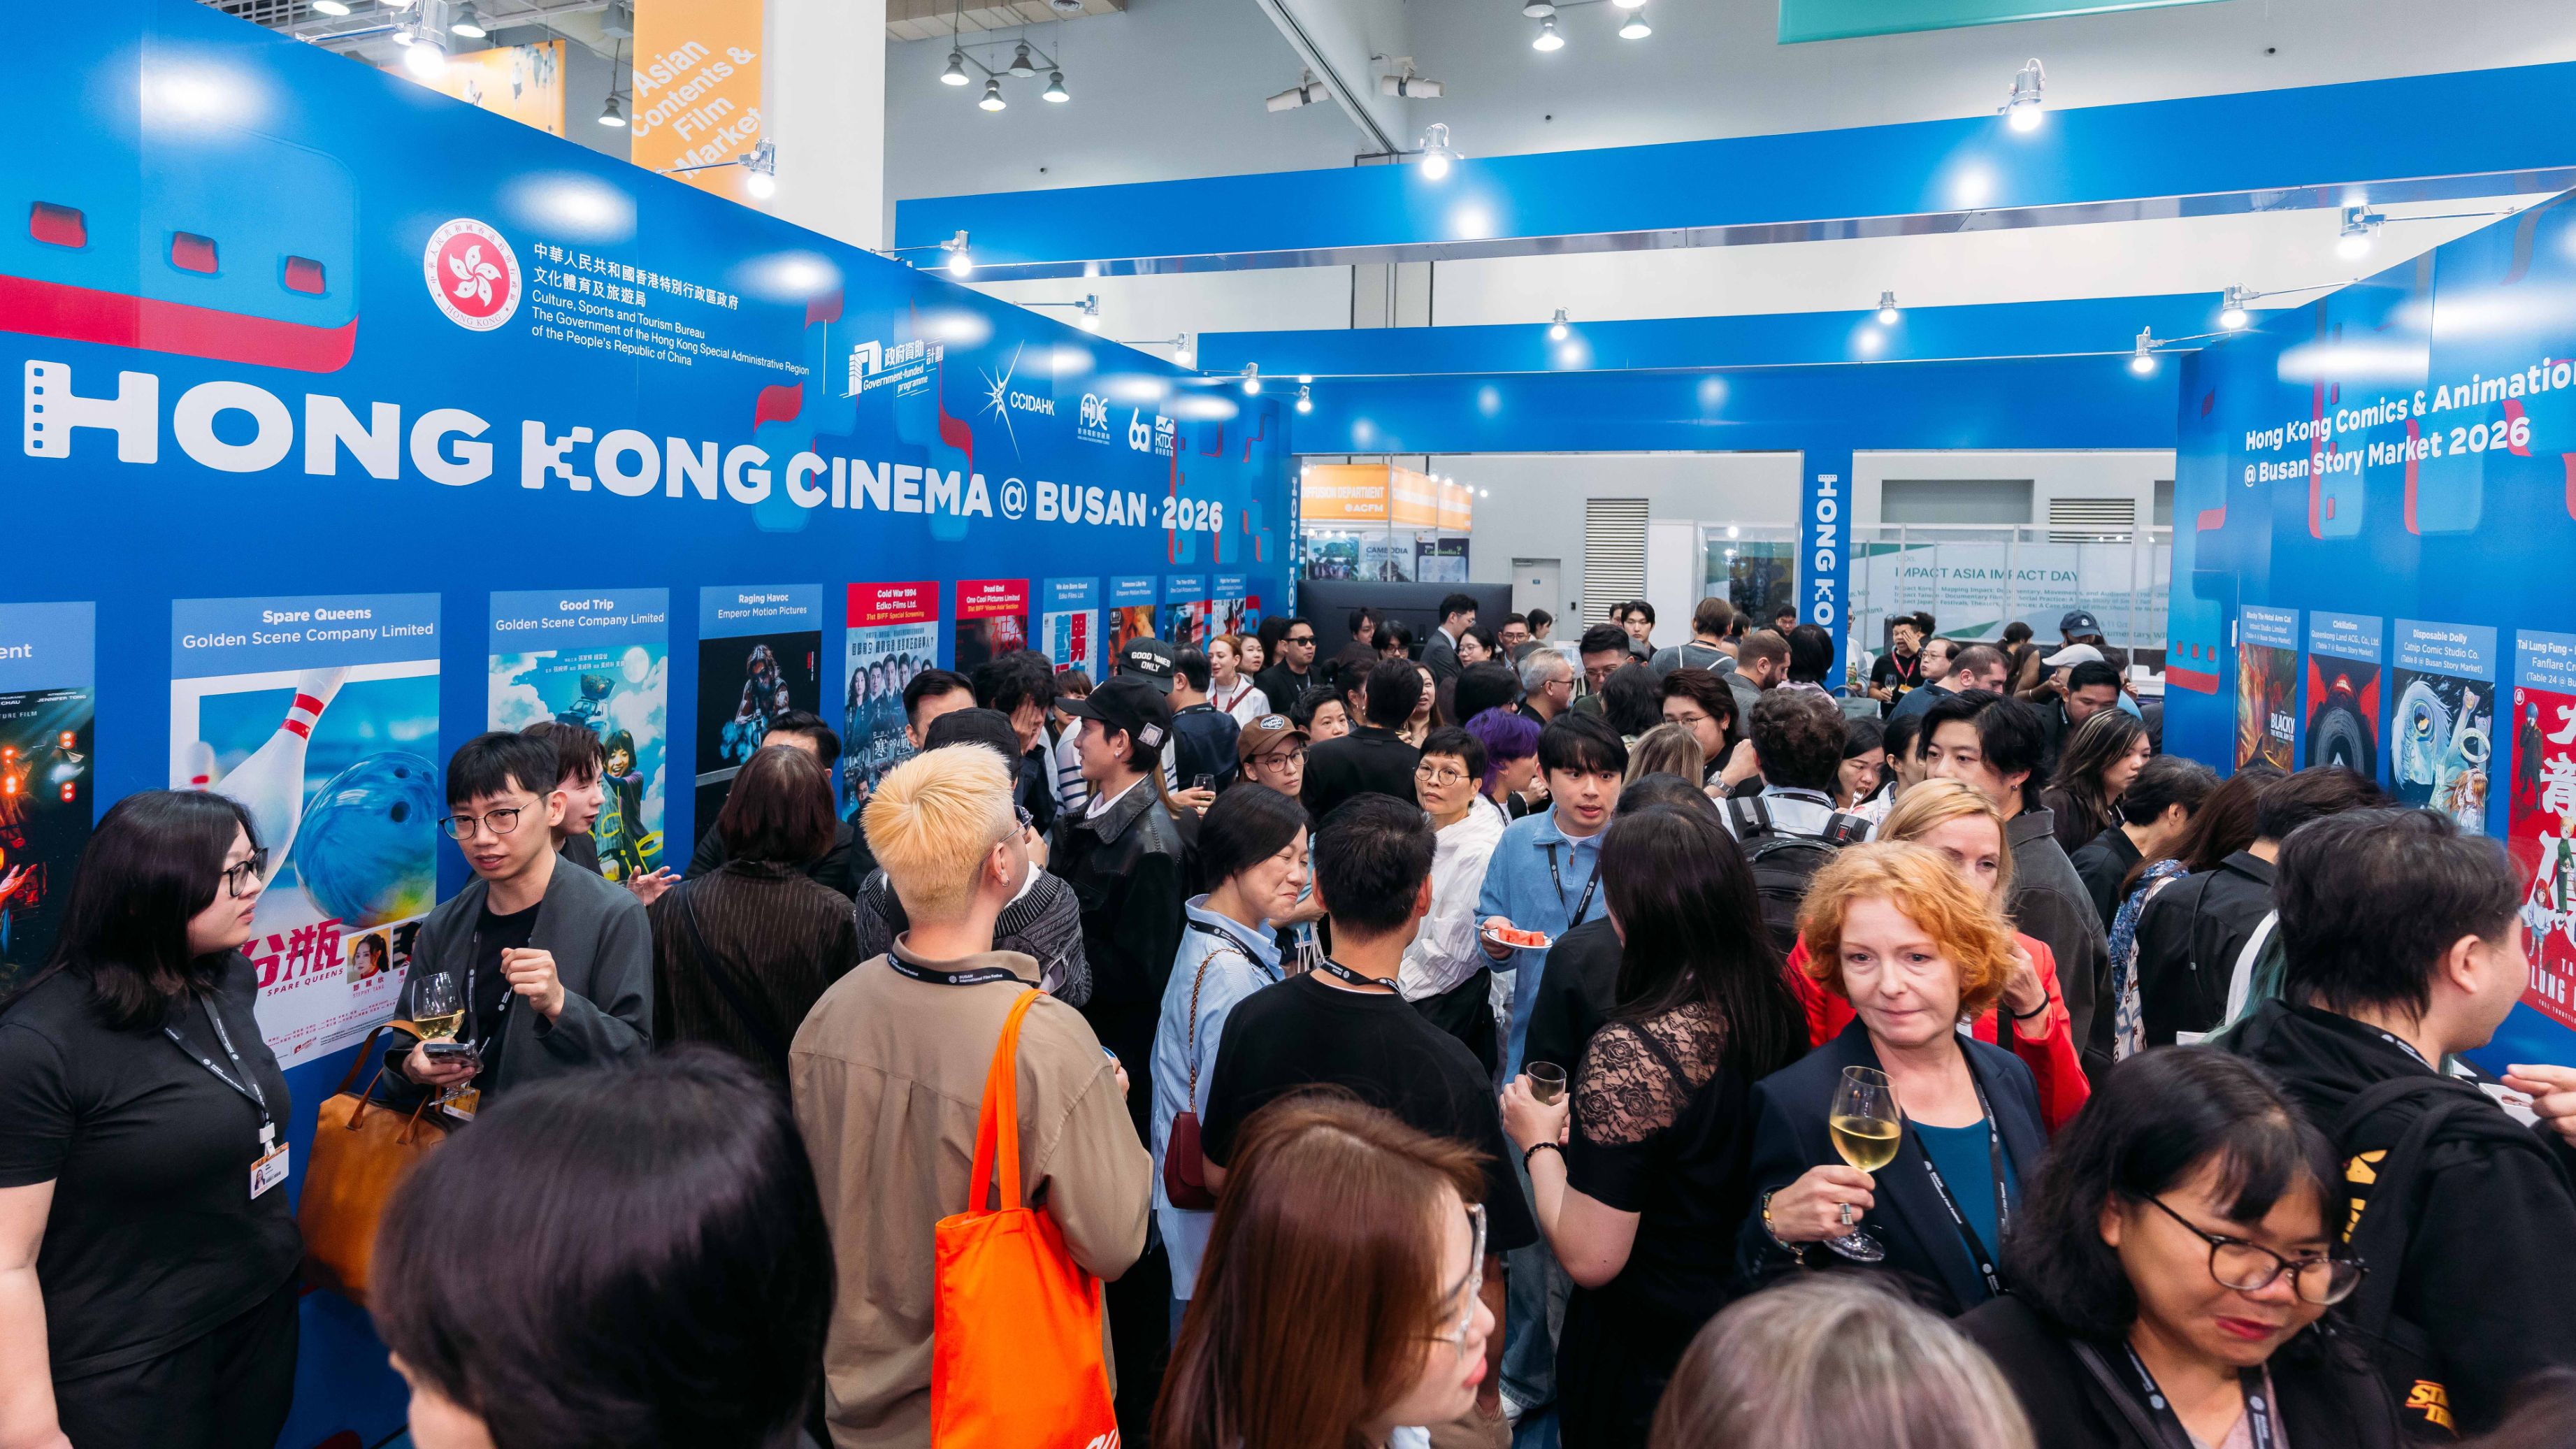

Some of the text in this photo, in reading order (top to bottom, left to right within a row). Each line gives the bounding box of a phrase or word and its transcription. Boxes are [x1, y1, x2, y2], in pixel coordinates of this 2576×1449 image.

[633, 41, 710, 98] Asian
[632, 47, 756, 137] Contents &
[672, 97, 735, 142] Film
[674, 107, 761, 180] Market
[534, 242, 739, 310] 中華人民共和國香港特別行政區政府
[533, 266, 647, 308] 文化體育及旅遊局
[446, 304, 502, 326] HONG KONG
[532, 289, 705, 339] Culture, Sports and Tourism Bureau
[532, 306, 810, 375] The Government of the Hong Kong Special Administrative Region
[532, 324, 692, 366] of the Republic of China
[884, 338, 944, 367] 政府資助 計劃
[863, 363, 924, 391] Government-funded
[898, 375, 928, 394] programme
[1010, 391, 1056, 417] CCIDAHK
[2245, 356, 2576, 452] Hong Kong Comics & Animatio
[24, 359, 1223, 533] HONG KONG CINEMA @ BUSAN 2026
[1155, 432, 1174, 450] HKTDC
[2244, 416, 2531, 488] @ Busan Story Market 2026
[1337, 485, 1384, 499] DEPARTMENT
[1353, 503, 1383, 512] ACFM
[1813, 474, 1838, 635] HONG KO
[1953, 568, 2078, 582] ASIA DAY
[738, 593, 789, 605] Raging Havoc
[877, 589, 893, 598] Cold
[904, 588, 917, 597] 1994
[559, 598, 614, 612] Good Trip
[718, 605, 807, 620] Emperor Motion Pictures
[876, 600, 917, 610] Edko Films Ltd.
[889, 611, 905, 619] Special
[262, 606, 372, 626] Spare Queens
[496, 612, 665, 631] Golden Scene Company Limited
[182, 622, 434, 650] Golden Scene Company Limited
[2310, 629, 2336, 642] Queenkong
[2336, 632, 2347, 642] Land
[2370, 636, 2380, 647] Ltd.
[2412, 628, 2468, 644] Disposable Dolly
[1131, 651, 1153, 661] GOOD
[2315, 641, 2374, 658] (Table Busan Story Market)
[2403, 642, 2480, 660] Catnip Comic Studio Co.
[2517, 639, 2568, 656] Tai Lung Fung
[1140, 661, 1161, 672] ONLY
[2401, 654, 2413, 664] (Table
[2425, 658, 2442, 668] Busan
[2444, 660, 2459, 672] Story
[2460, 661, 2484, 675] Market)
[2532, 656, 2565, 672] Fanflare
[2526, 671, 2566, 687] (Table 24 @
[2271, 712, 2296, 735] BLACKY
[266, 967, 344, 997] SPARE QUEENS
[2531, 965, 2566, 1004] LUNG
